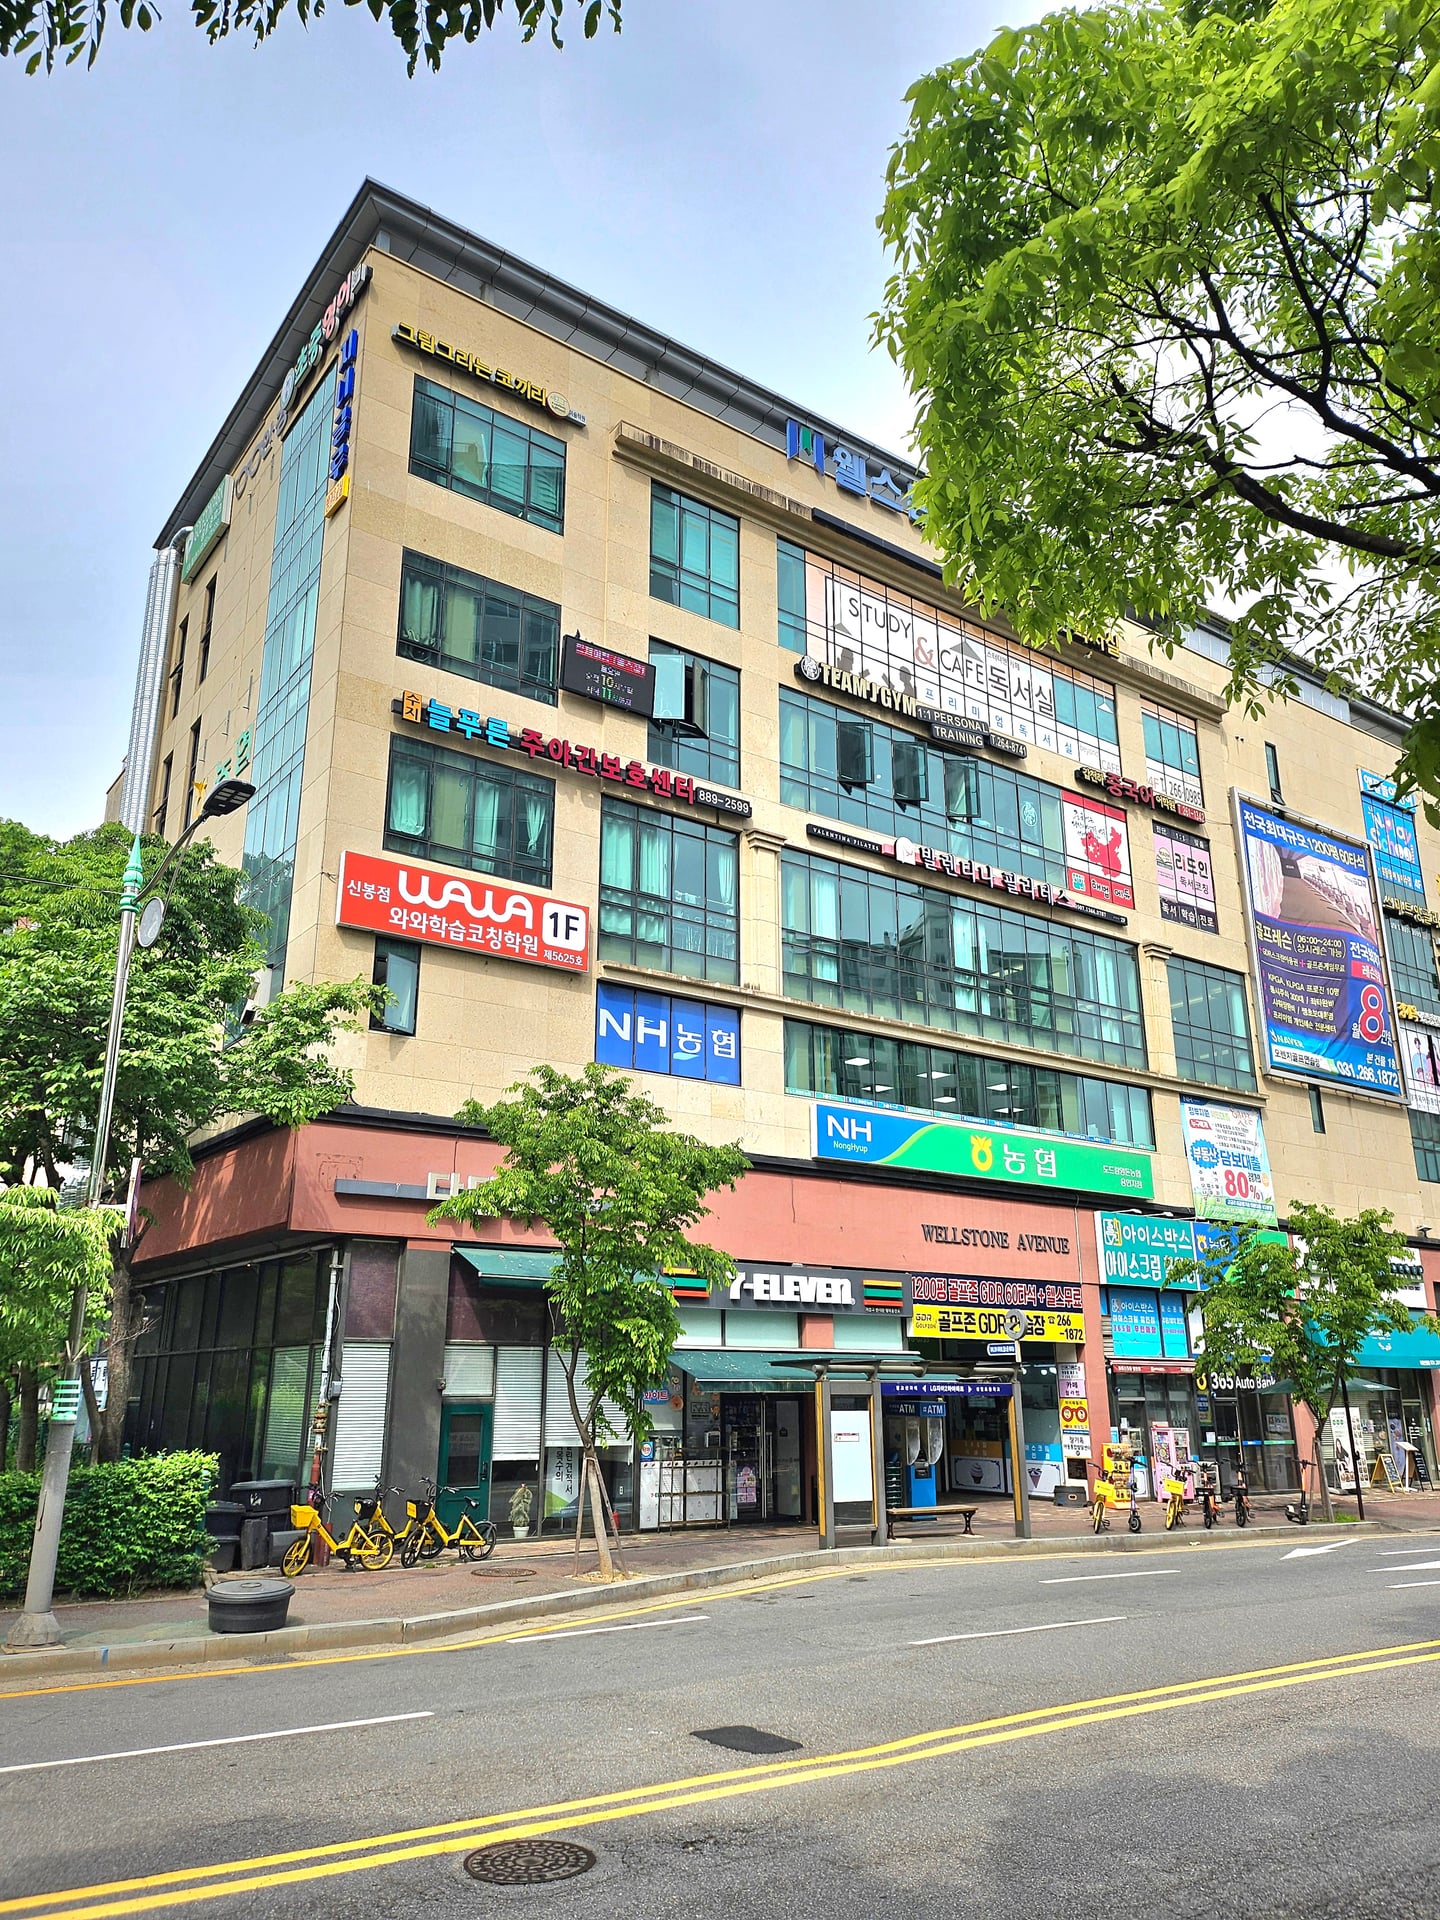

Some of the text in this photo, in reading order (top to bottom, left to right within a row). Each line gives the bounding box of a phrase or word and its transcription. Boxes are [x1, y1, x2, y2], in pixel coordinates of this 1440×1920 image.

[396, 321, 494, 380] 그림그리는
[495, 367, 547, 407] 코끼리
[833, 445, 928, 521] 웰스
[848, 597, 985, 686] STUDY & CAFE
[880, 686, 917, 718] GYM
[988, 664, 1055, 718] 독서실
[917, 706, 989, 734] 1:1 PERSONAL
[933, 725, 984, 747] TRAINING
[405, 692, 750, 815] 수지 늘푸른 주야간보호센터 889-2599
[1106, 772, 1155, 809] 중국어
[812, 827, 880, 852] VALENTINA PILATES
[1243, 809, 1309, 850] 전국최대규모
[346, 879, 391, 903] 신봉점
[919, 846, 1076, 905] 발렌티나 필라테스
[388, 906, 539, 957] 와와학습코칭학원
[549, 911, 580, 941] 1F
[1255, 920, 1292, 951] 골프레슨
[543, 948, 584, 967] 제5625호
[1358, 984, 1385, 1044] 8
[599, 1008, 736, 1060] NH 농협
[1336, 1059, 1400, 1088] 031.266.1872
[825, 1114, 872, 1143] NH
[833, 1140, 869, 1154] NongHyup
[1003, 1143, 1057, 1179] 농협
[1192, 1146, 1262, 1172] 부동산 담보대출
[921, 1223, 1070, 1254] WELLSTONE AVENUE
[1122, 1223, 1193, 1254] 아이스박스
[1105, 1249, 1162, 1282] 아이스크림
[912, 1276, 947, 1301] 1200평
[948, 1280, 979, 1304] 골프존
[980, 1281, 1005, 1305] GDR
[1005, 1283, 1037, 1307] 60타석
[1045, 1287, 1083, 1308] 헬스무료
[916, 1313, 932, 1322] GDR
[938, 1310, 976, 1333] 골프존
[1057, 1314, 1071, 1327] 266
[1121, 1302, 1154, 1314] 아이스박스
[1059, 1328, 1083, 1341] -1872
[643, 1391, 669, 1401] 화이트
[1211, 1371, 1276, 1390] 365 Auto Bank
[899, 1404, 943, 1414] ATM ATM
